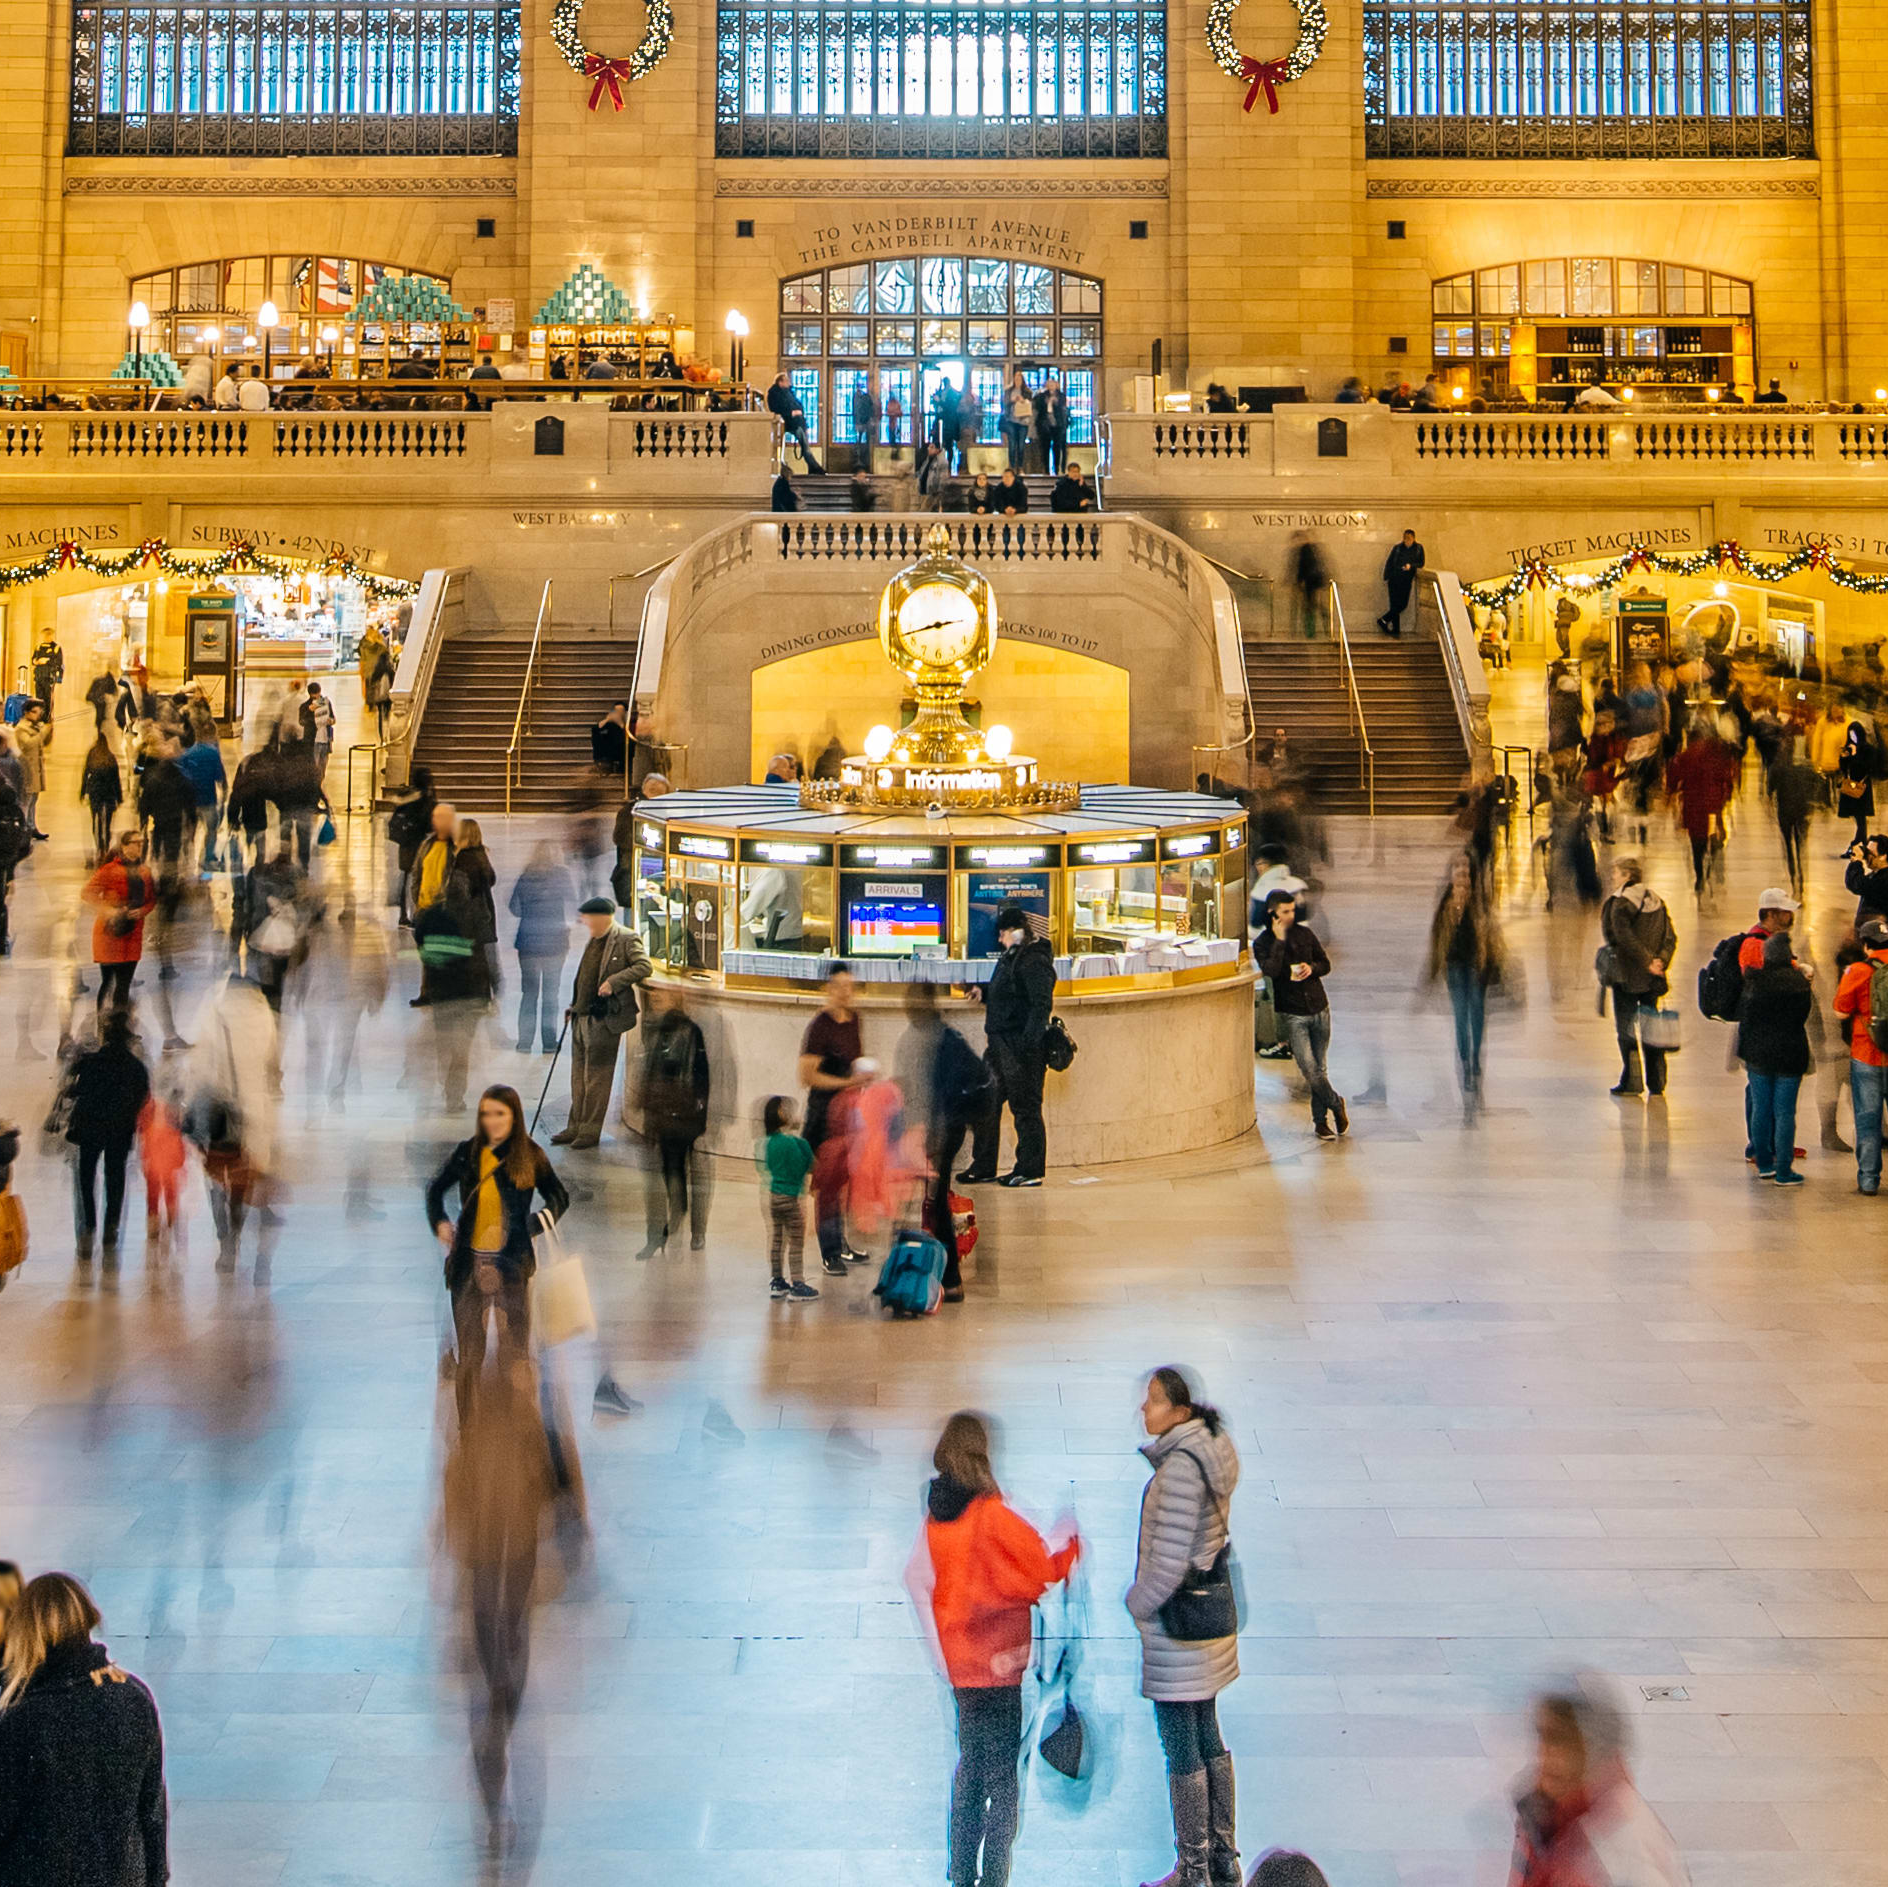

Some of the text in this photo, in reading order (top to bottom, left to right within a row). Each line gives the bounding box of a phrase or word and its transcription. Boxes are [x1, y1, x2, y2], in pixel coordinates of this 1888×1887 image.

[814, 217, 1070, 243] TO VANDERBILT AVENUE
[798, 234, 1086, 265] THE CAMPBELL APARTMENT
[513, 512, 631, 525] WEST BALOY
[1252, 514, 1370, 527] WEST BALCONY
[6, 522, 120, 549] MACHINES
[192, 524, 376, 564] SUBWAY 42ND ST
[1506, 528, 1692, 563] TICKET MACHINES
[1763, 528, 1845, 550] TRACKS
[1848, 536, 1867, 552] 31
[761, 620, 1099, 660] DINING CONCOU ACKS 100 TO 117
[935, 648, 942, 659] 6
[905, 769, 1002, 790] Information
[868, 885, 920, 896] ARRIVALS
